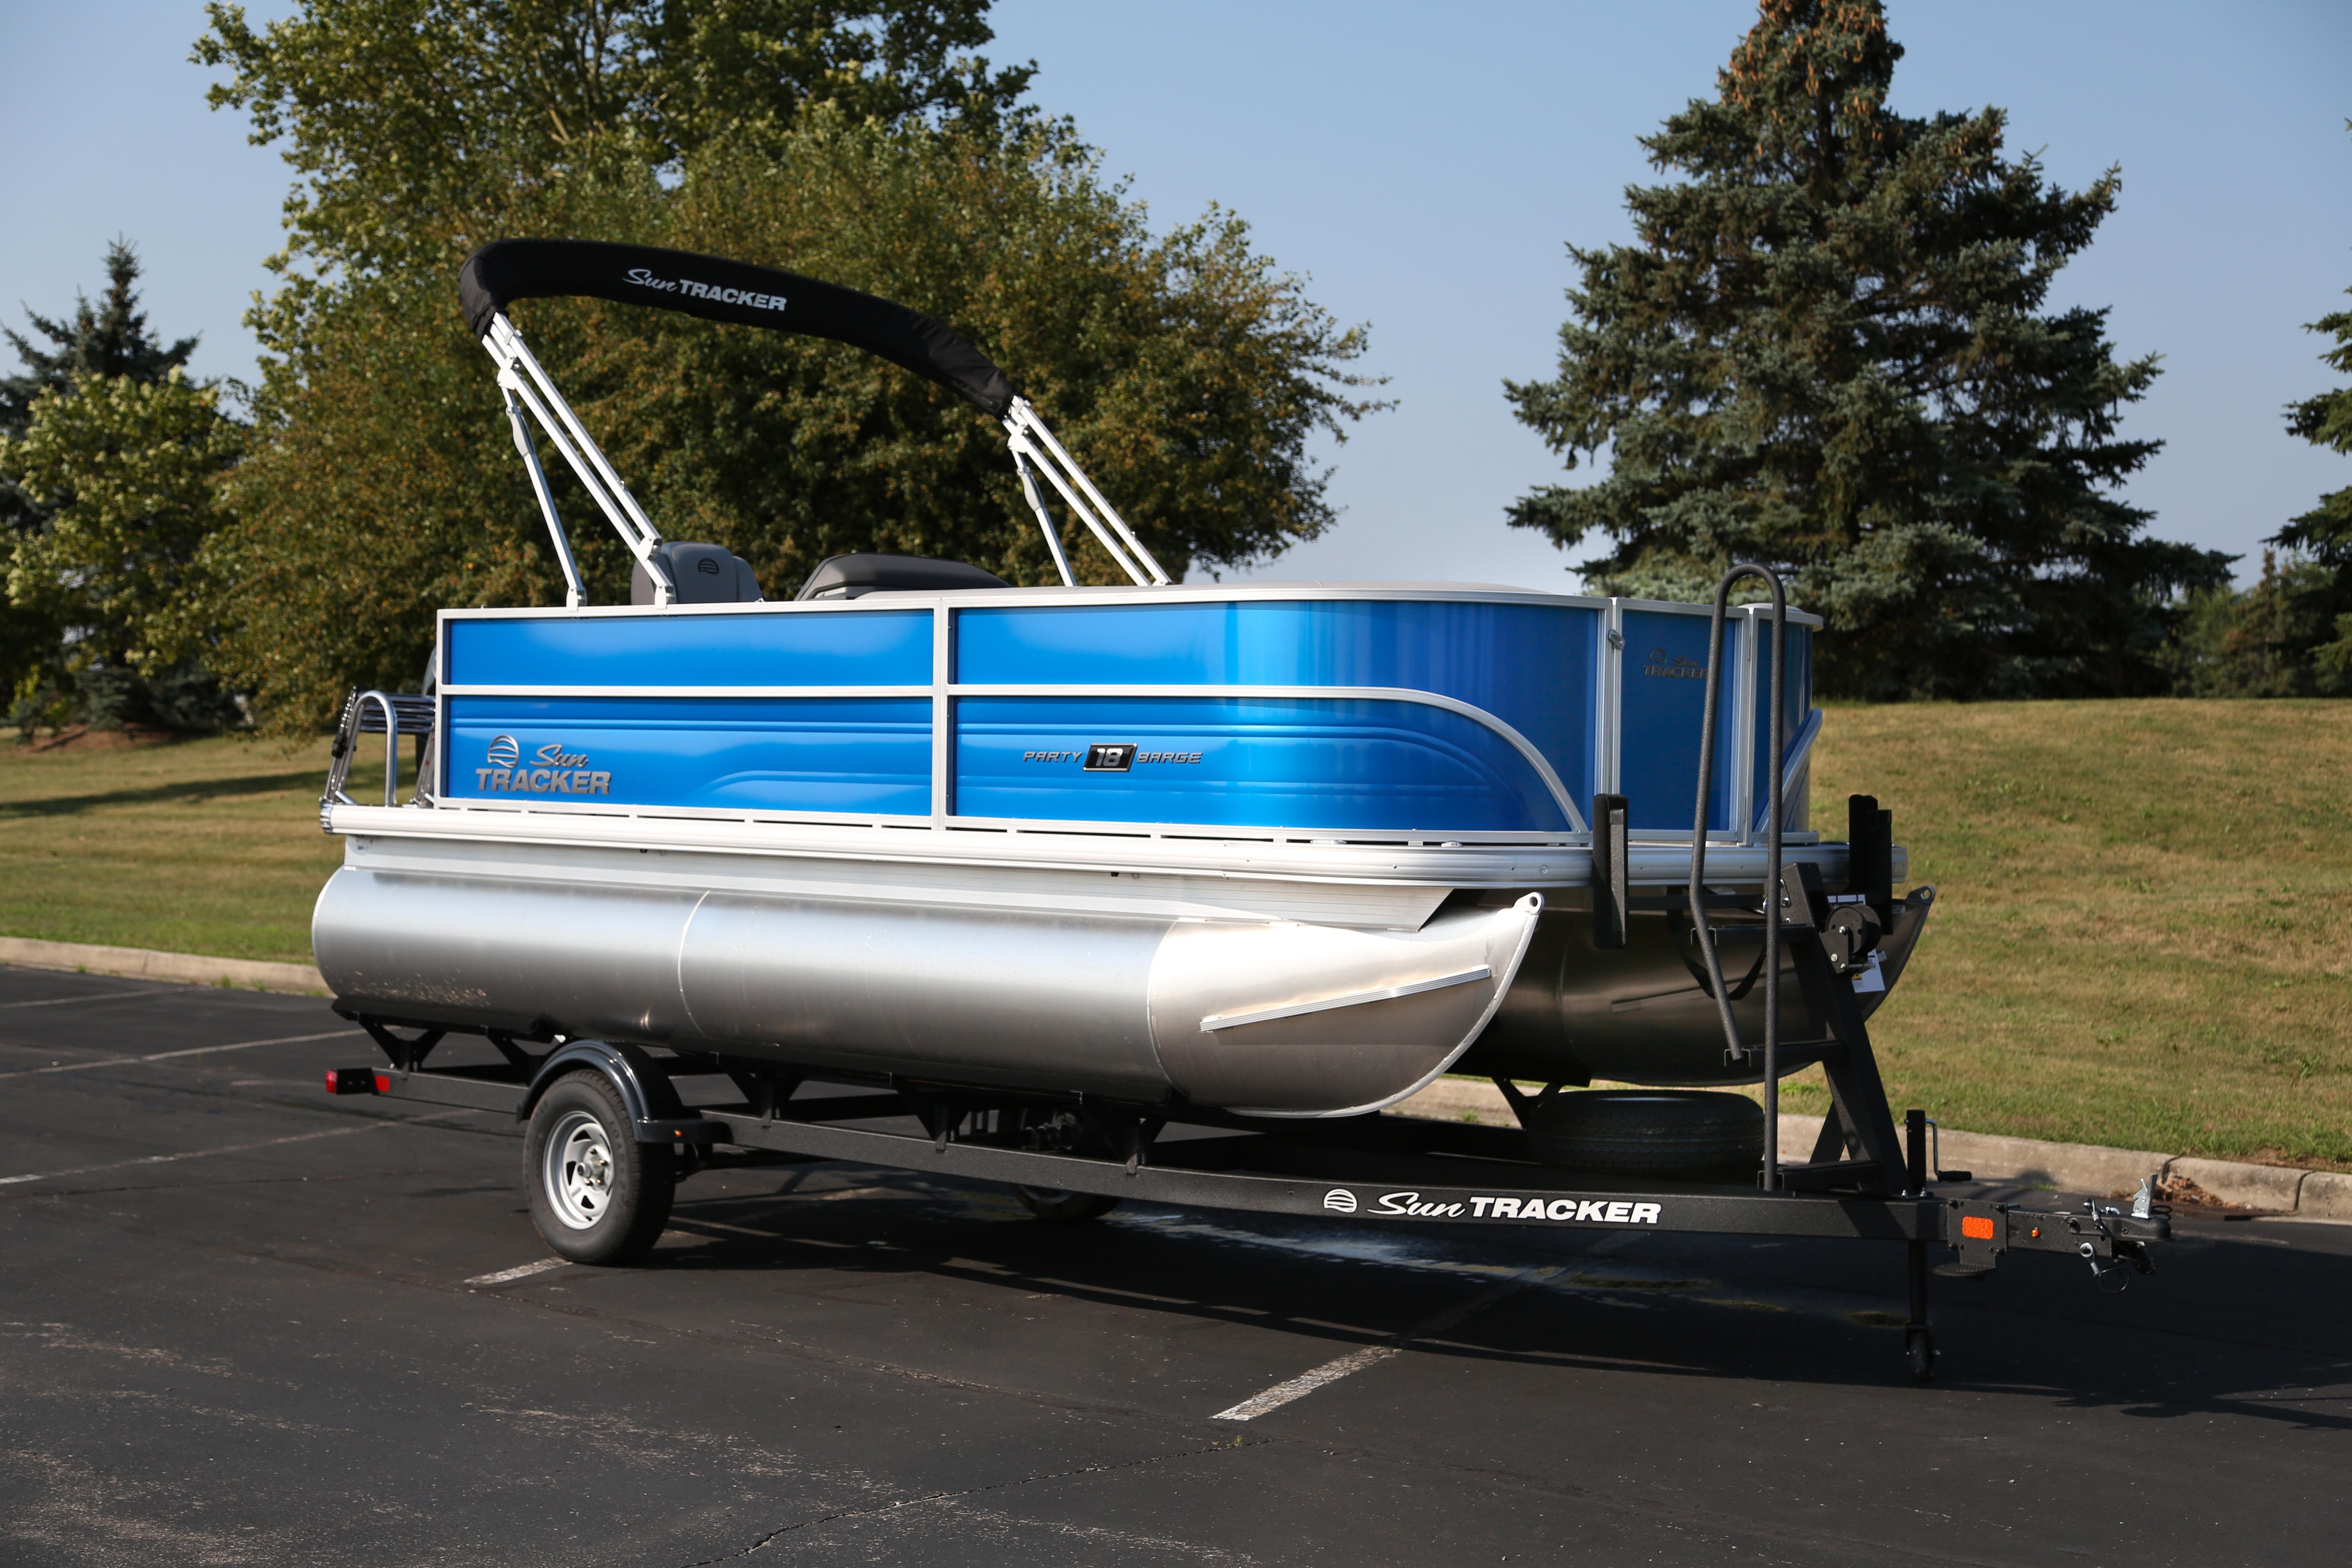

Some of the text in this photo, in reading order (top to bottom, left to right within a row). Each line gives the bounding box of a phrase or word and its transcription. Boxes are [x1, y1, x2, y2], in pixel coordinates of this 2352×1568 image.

[621, 269, 787, 311] Sun TRACKER
[1670, 655, 1699, 666] Sun
[529, 744, 589, 768] Sun
[1022, 747, 1203, 766] PARTY 18 BARGE
[475, 768, 611, 795] TRACKER
[1367, 1192, 1662, 1224] Sun TRACKER
